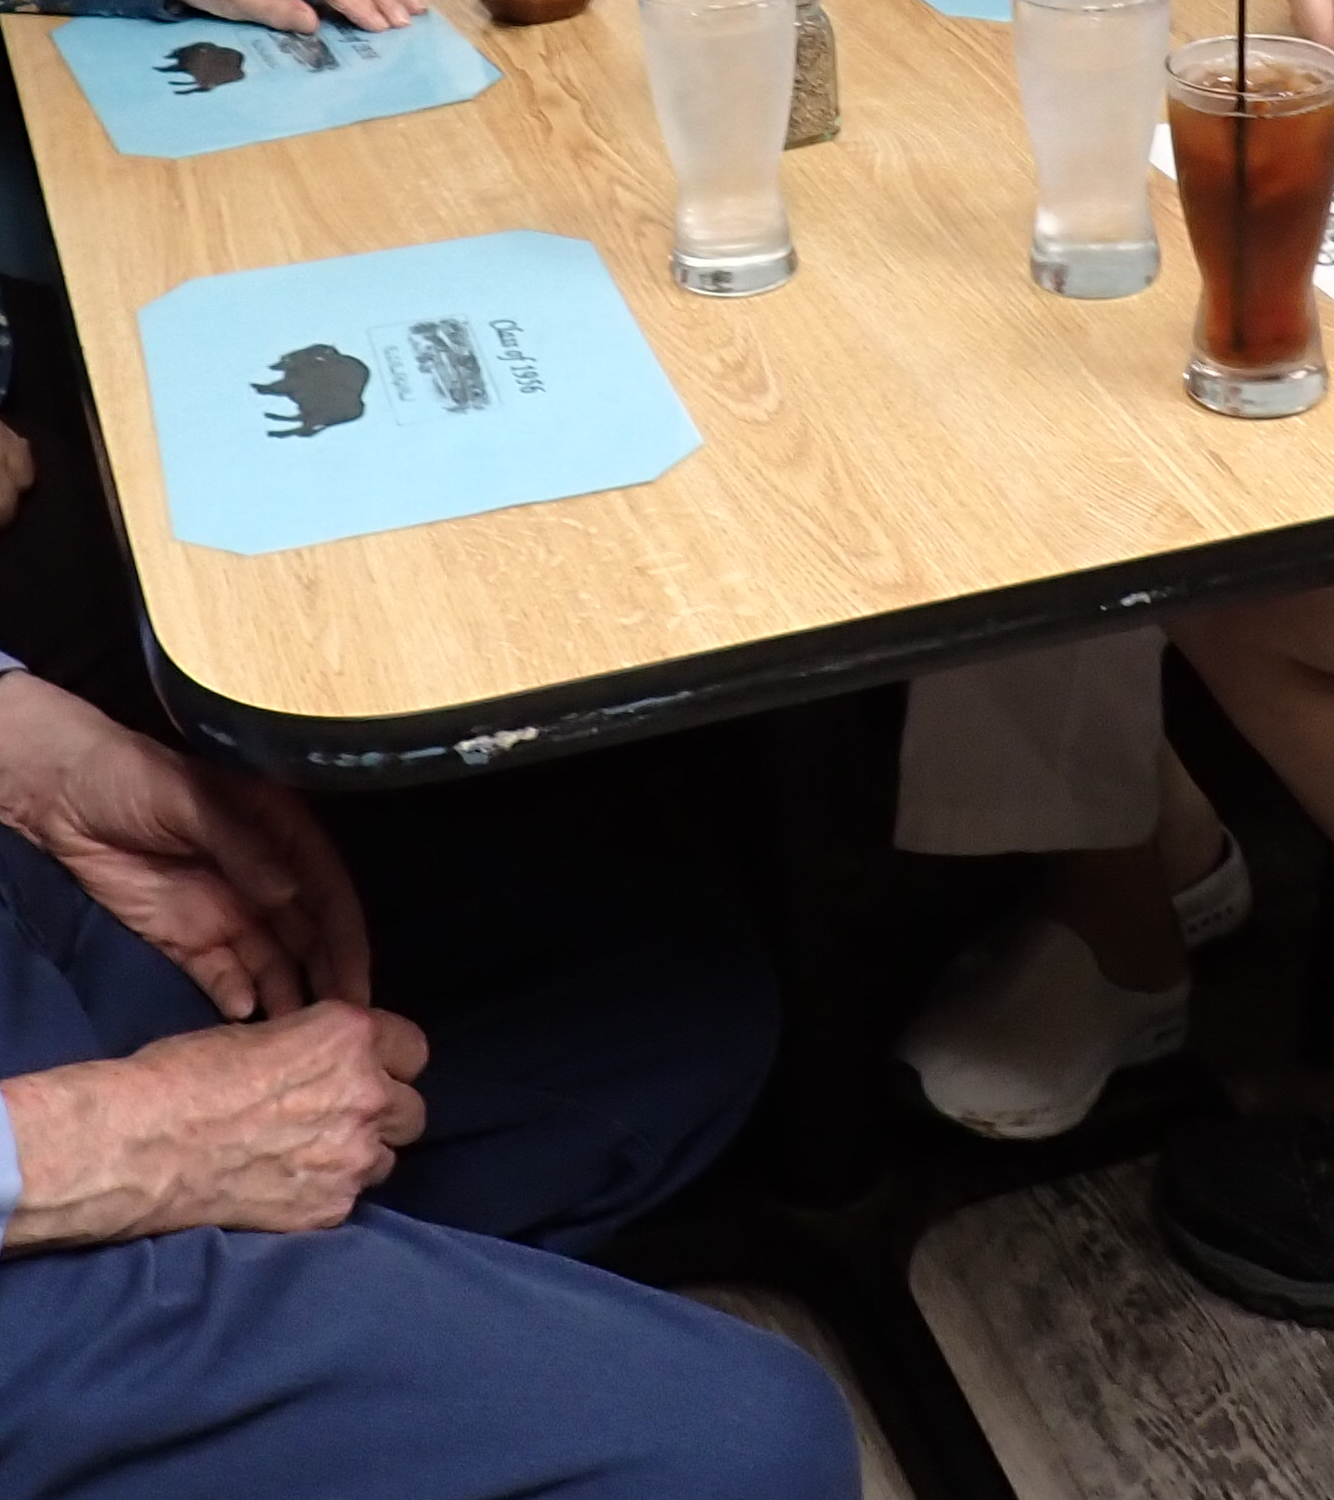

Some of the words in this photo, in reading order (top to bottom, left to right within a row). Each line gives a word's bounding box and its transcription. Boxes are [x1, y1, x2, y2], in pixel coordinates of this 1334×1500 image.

[488, 319, 524, 348] Class
[496, 350, 537, 362] of
[510, 365, 547, 394] 1956
